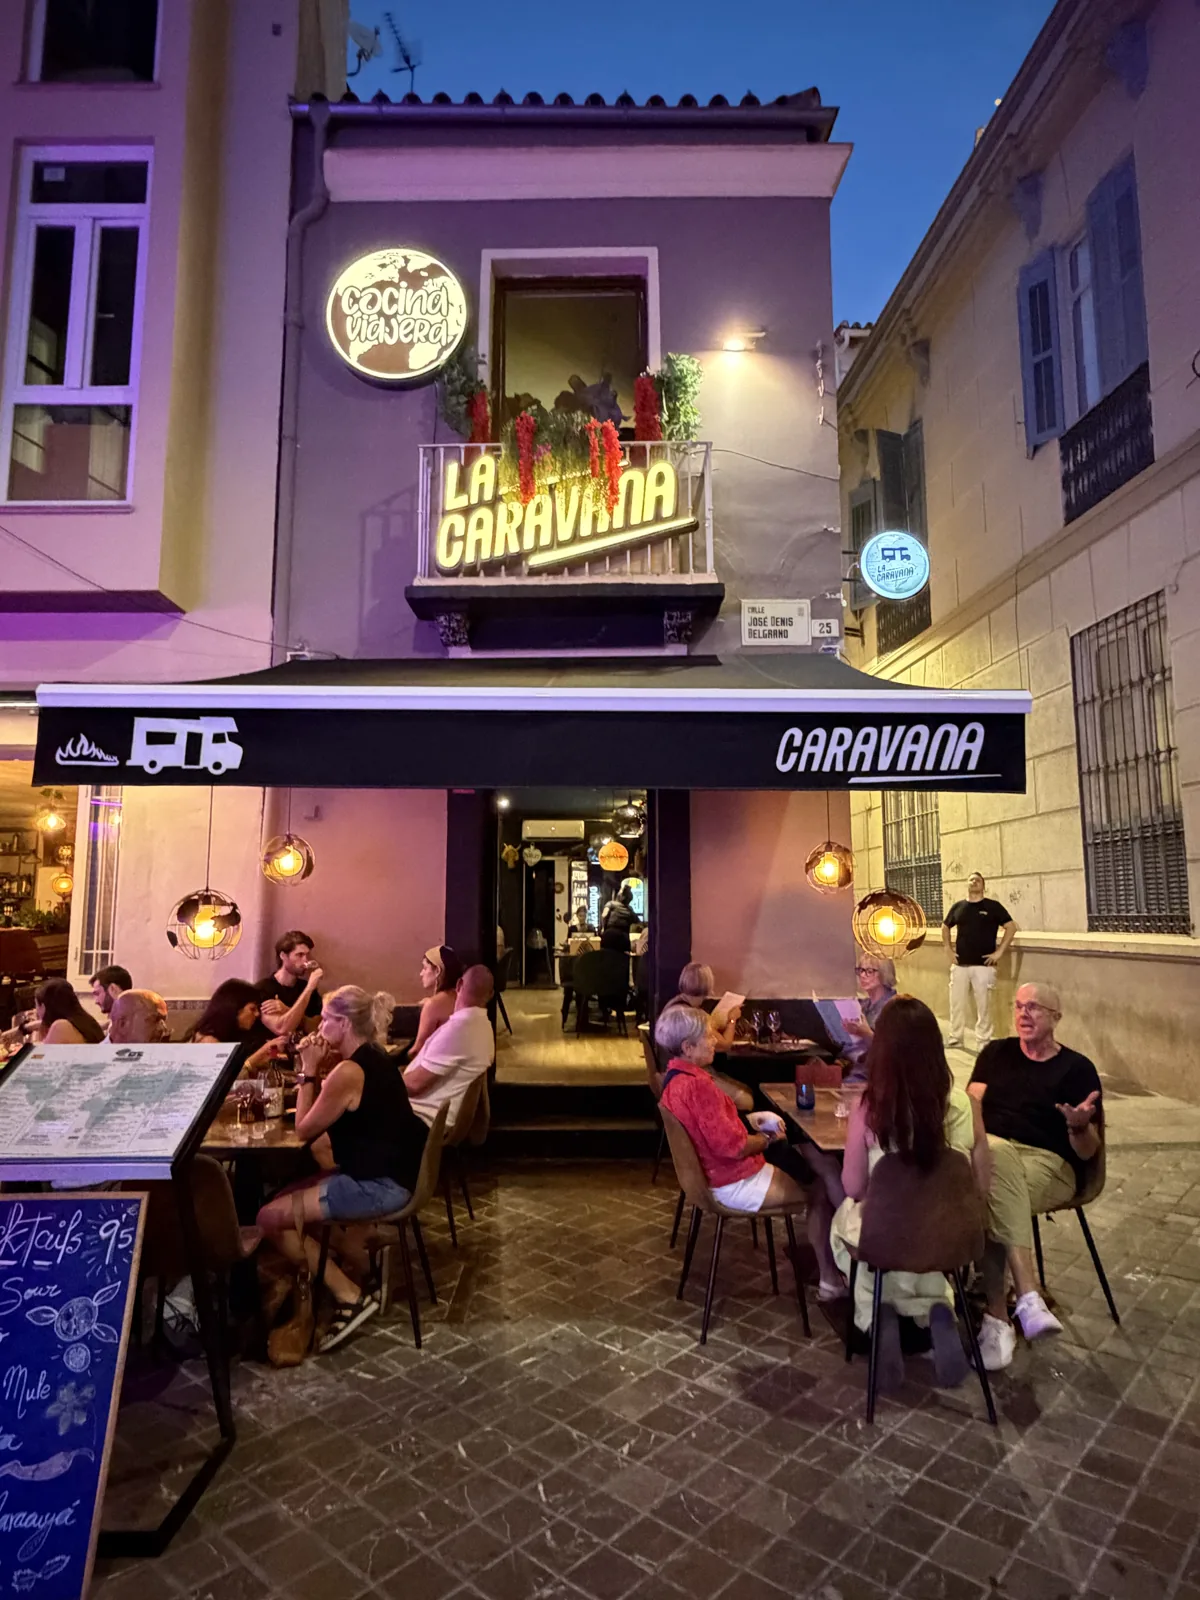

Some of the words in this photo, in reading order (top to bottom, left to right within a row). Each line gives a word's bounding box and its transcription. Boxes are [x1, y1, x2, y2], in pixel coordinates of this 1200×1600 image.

[445, 455, 496, 511] LA
[436, 460, 677, 569] CARAVANA
[877, 565, 886, 573] LA
[877, 566, 914, 582] CARAVANA
[748, 606, 765, 614] CALLE
[748, 616, 768, 627] JOSÉ
[771, 616, 794, 627] DENIS
[818, 622, 833, 634] 25
[748, 628, 789, 639] BELGRANO
[775, 721, 985, 773] CARAVANA
[0, 1276, 62, 1316] Sour
[3, 1365, 51, 1420] Mule
